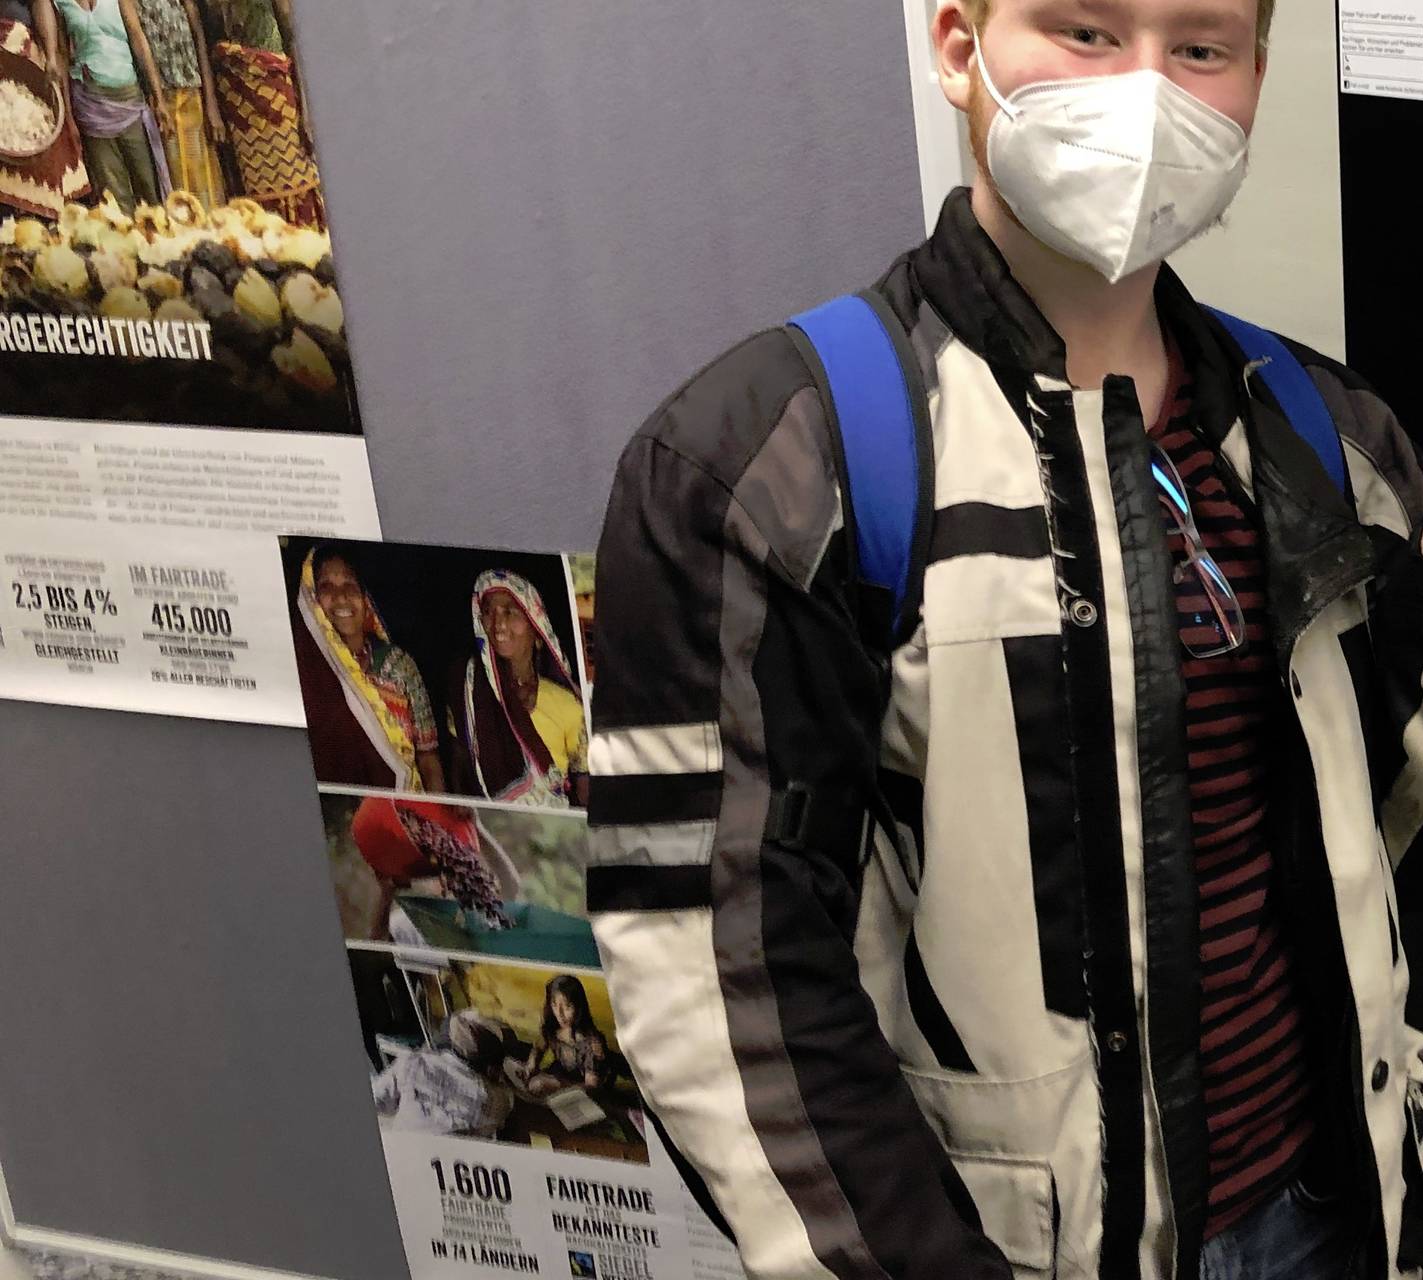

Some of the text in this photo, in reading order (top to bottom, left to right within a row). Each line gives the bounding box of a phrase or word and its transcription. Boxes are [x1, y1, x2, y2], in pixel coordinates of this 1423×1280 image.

[129, 565, 147, 584] IM
[12, 582, 118, 616] 2,5 BIS 4%
[43, 612, 97, 634] STEIGEN,
[151, 602, 232, 637] 415.000
[34, 643, 120, 664] GLEICHGESTELLT
[431, 1157, 512, 1204] 1.600
[545, 1173, 657, 1215] FAIRTRADE
[552, 1210, 661, 1248] BEKANNTESTE
[431, 1239, 448, 1259] IN
[471, 1243, 540, 1275] LÄNDERN
